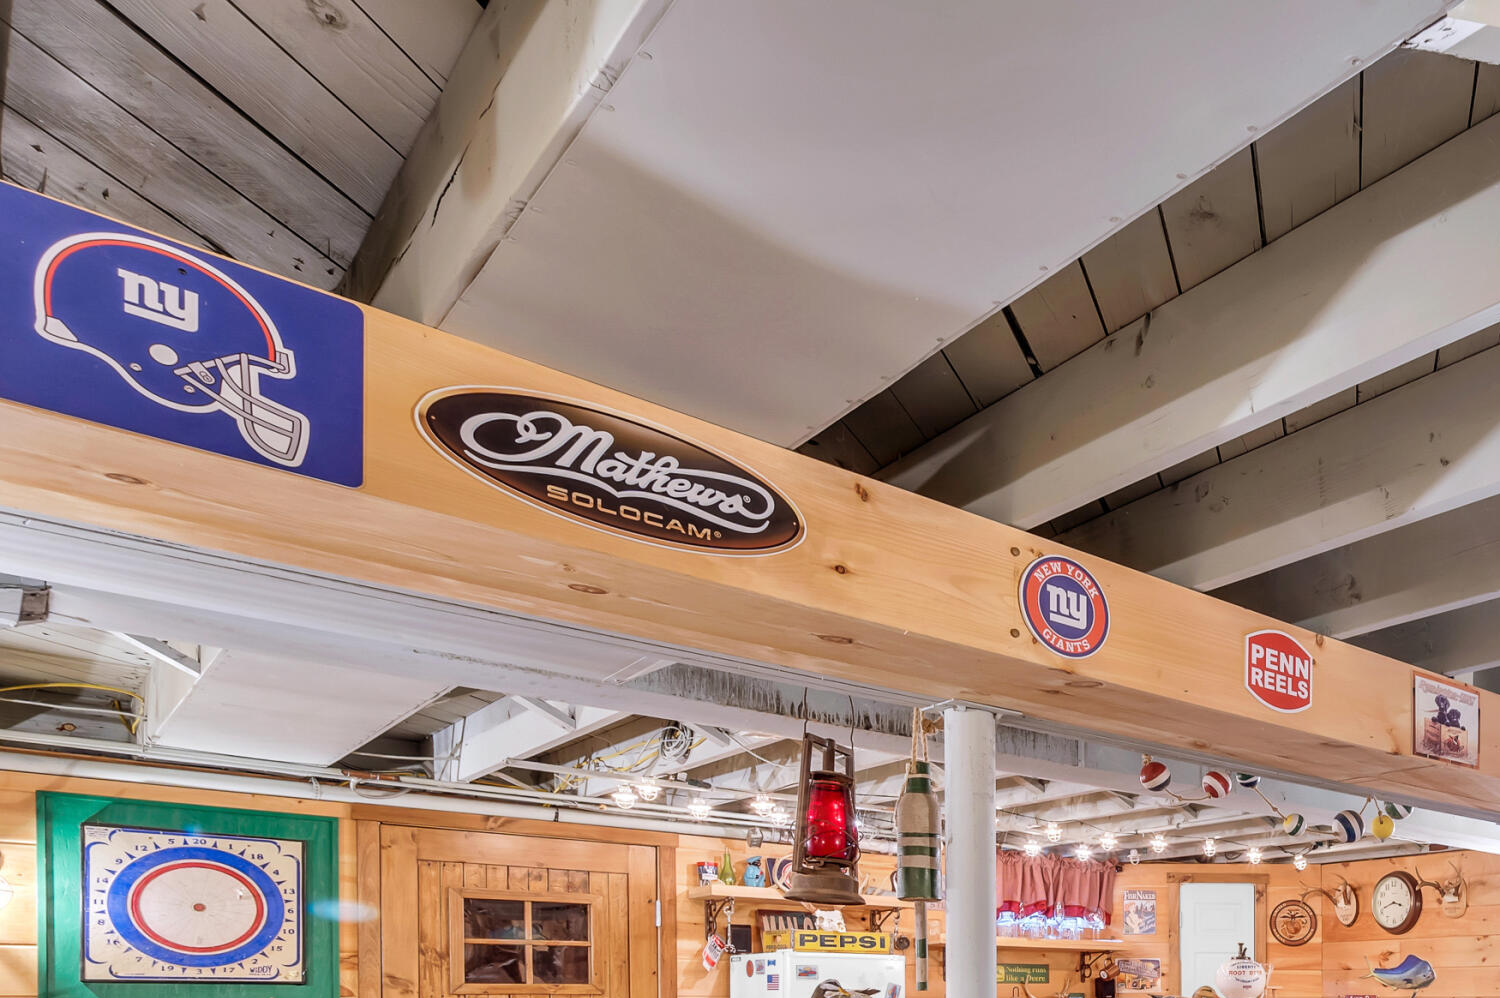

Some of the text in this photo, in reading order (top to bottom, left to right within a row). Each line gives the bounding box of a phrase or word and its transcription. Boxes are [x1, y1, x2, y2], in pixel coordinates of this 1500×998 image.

[1033, 561, 1100, 599] NEW YORK
[1042, 628, 1091, 653] GIANTS
[1251, 643, 1310, 680] PENN
[1251, 666, 1309, 700] REELS
[135, 844, 148, 852] 12
[799, 932, 887, 949] PEPSI
[1006, 966, 1031, 974] Nothing
[1006, 974, 1018, 982] like
